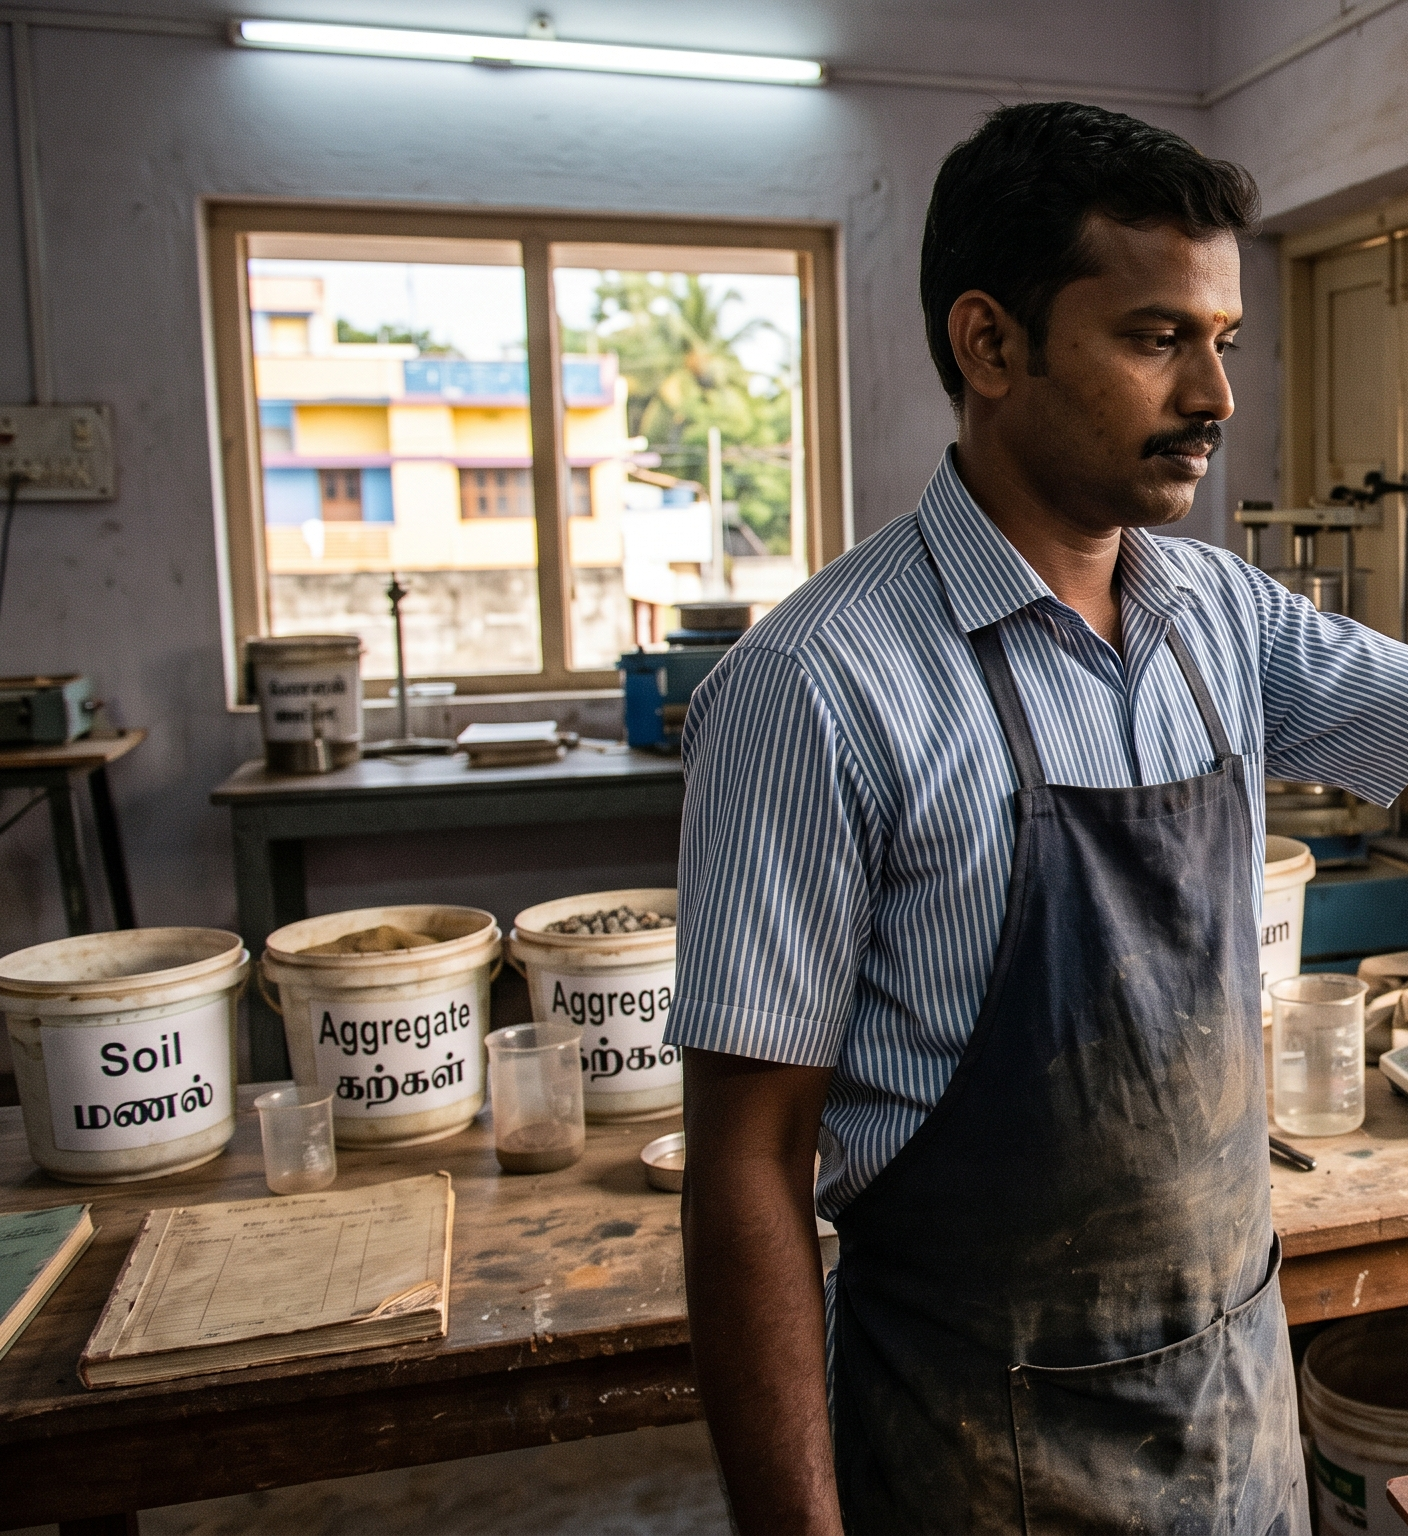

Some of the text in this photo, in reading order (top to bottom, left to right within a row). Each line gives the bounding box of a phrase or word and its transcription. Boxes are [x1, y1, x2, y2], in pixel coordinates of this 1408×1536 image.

[319, 1001, 470, 1056] Aggregate
[552, 980, 672, 1026] Aggrega
[100, 1031, 182, 1077] Soil
[336, 1052, 465, 1109] கற்கள்
[74, 1074, 213, 1130] மணல்
